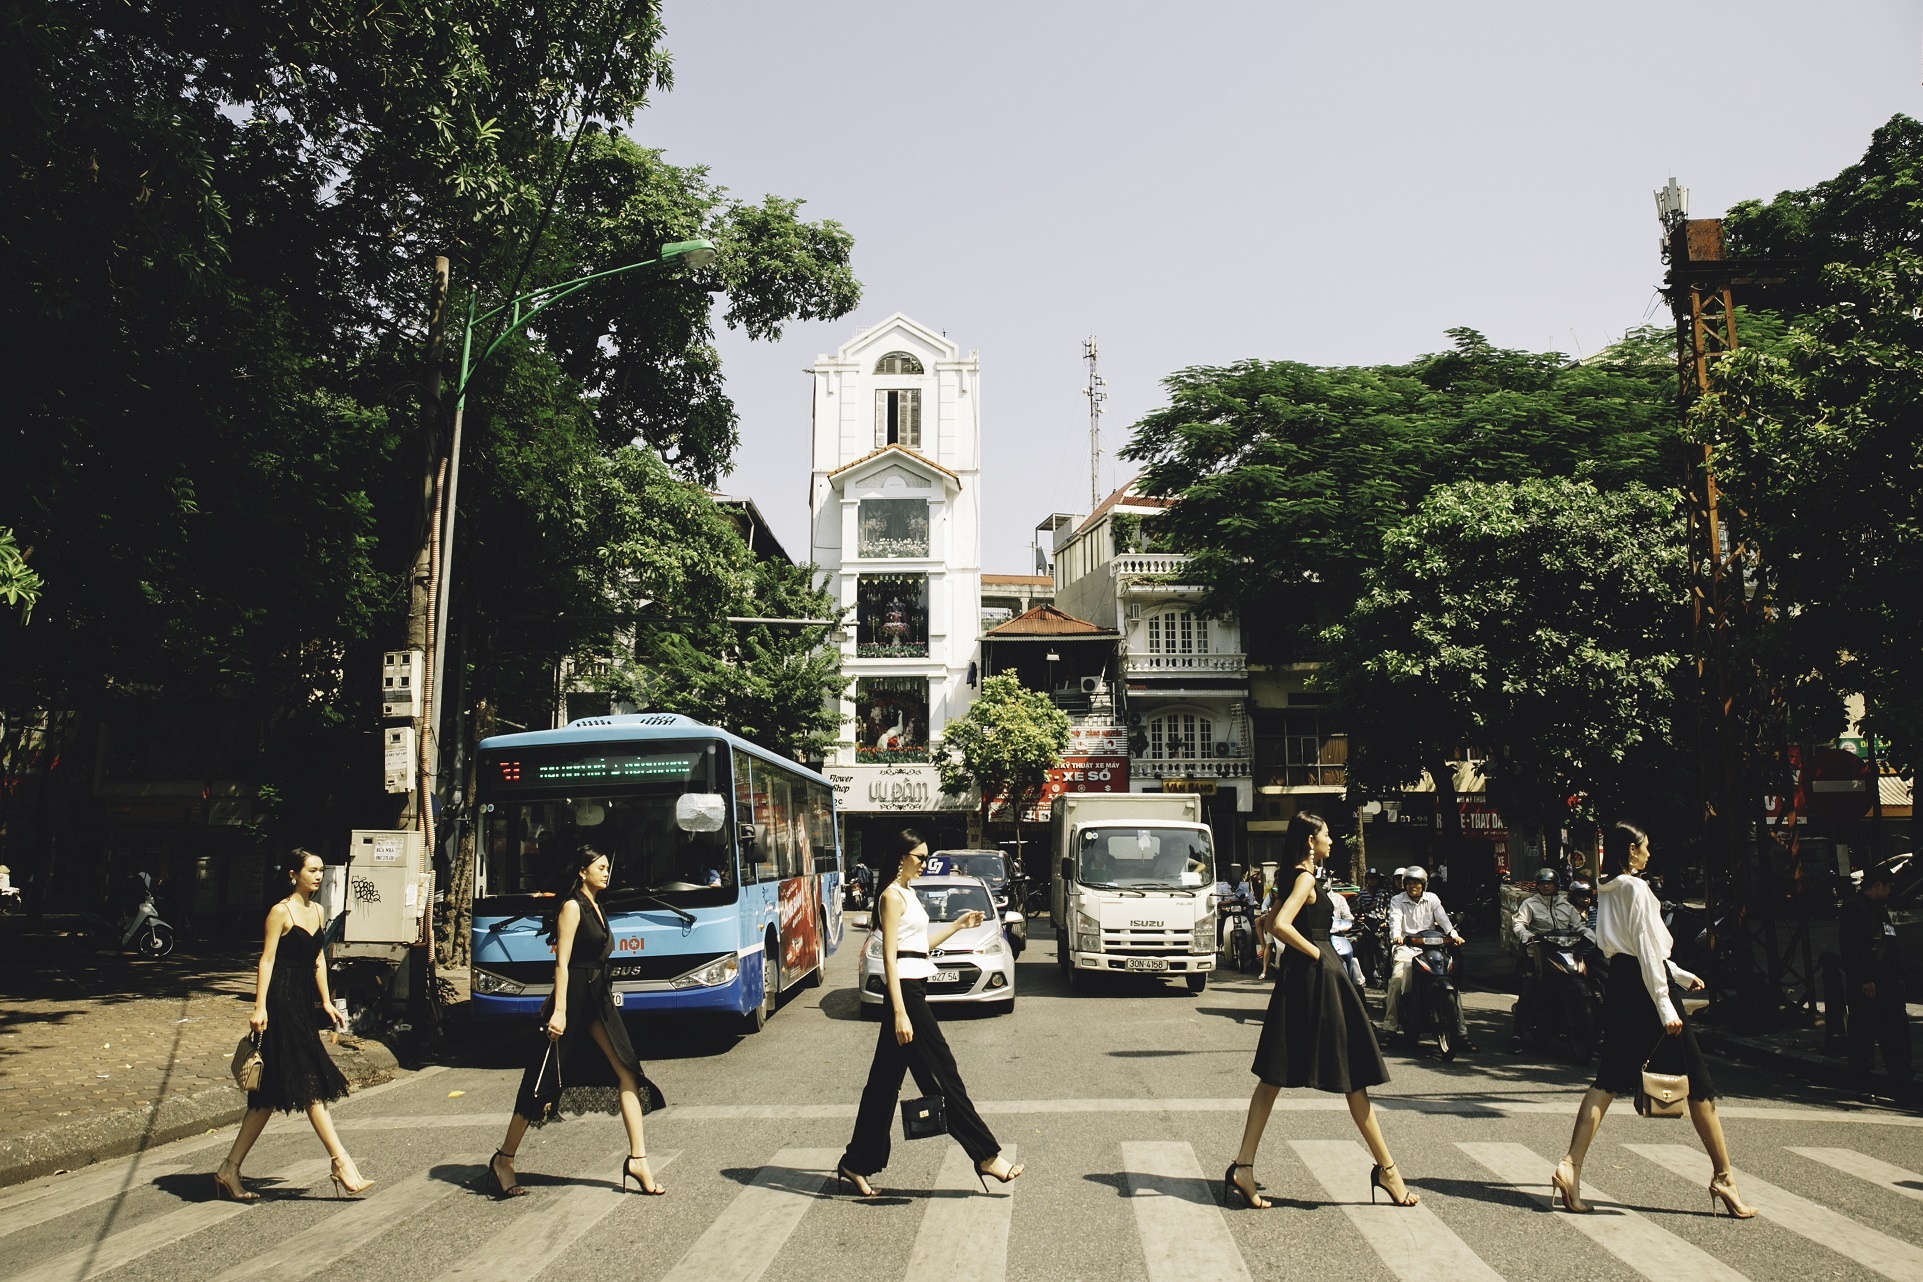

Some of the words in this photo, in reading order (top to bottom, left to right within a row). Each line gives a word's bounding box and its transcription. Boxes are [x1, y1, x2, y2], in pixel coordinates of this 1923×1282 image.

[1072, 762, 1094, 770] THUẬT
[1105, 761, 1120, 769] MÁY
[829, 774, 854, 783] Flower
[1063, 772, 1085, 782] XE
[1087, 768, 1112, 782] SỐ
[1470, 813, 1491, 829] THAY
[611, 966, 641, 977] BUS
